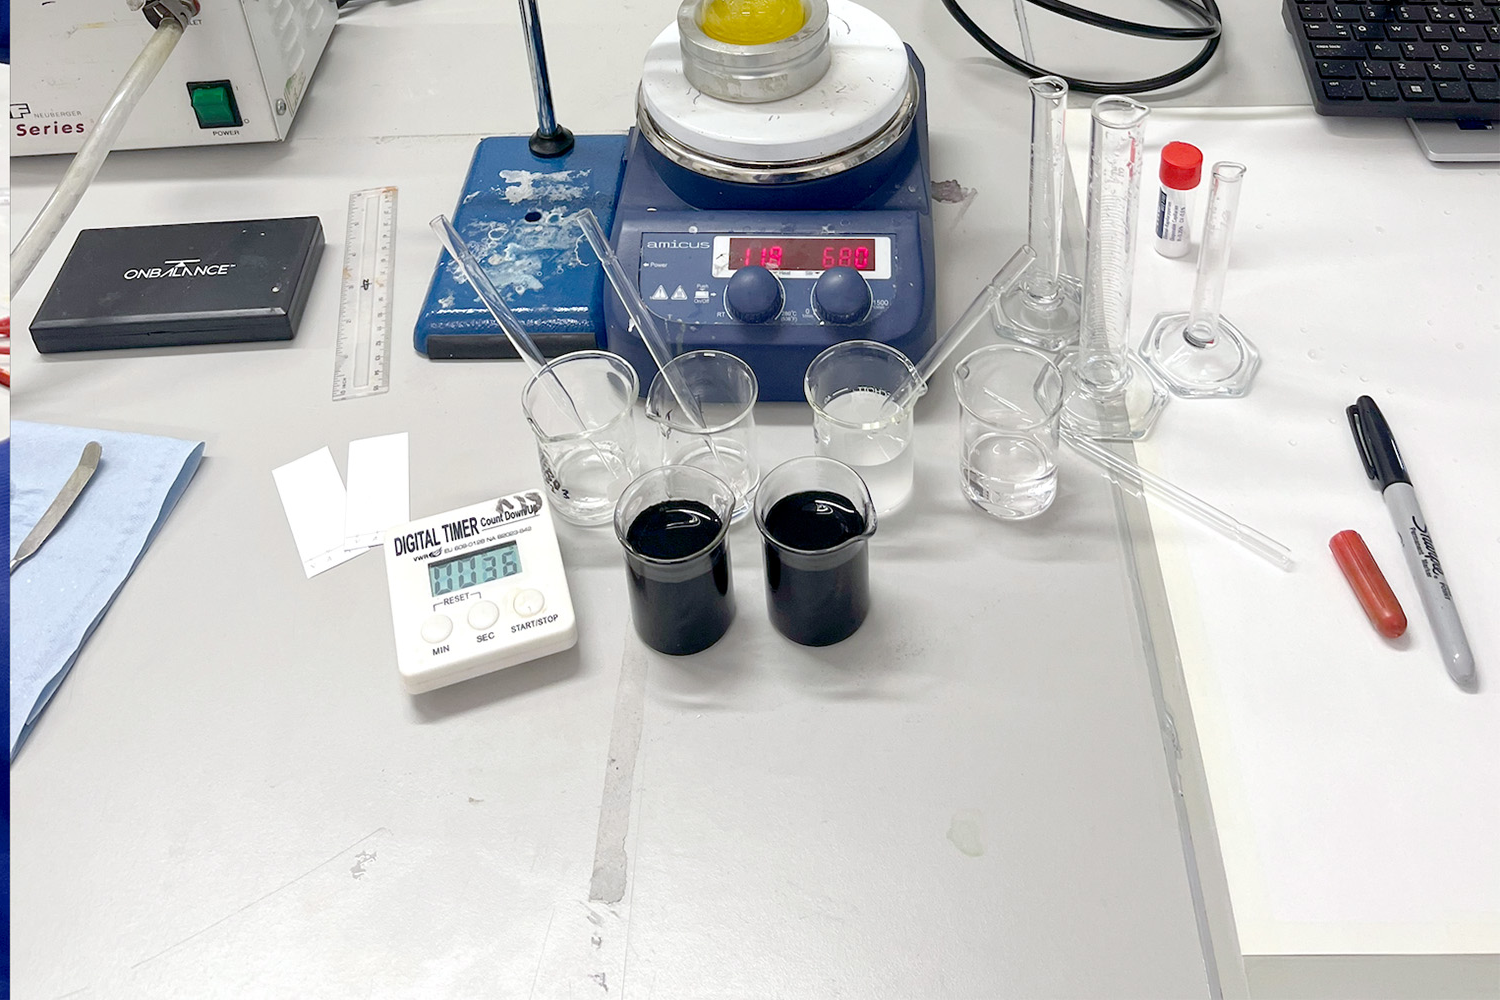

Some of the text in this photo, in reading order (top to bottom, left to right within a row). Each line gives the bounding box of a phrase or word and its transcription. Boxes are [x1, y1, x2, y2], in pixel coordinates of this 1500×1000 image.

[33, 110, 83, 119] NEUBERGER
[16, 120, 85, 137] Series
[647, 240, 710, 249] amicus
[822, 246, 869, 269] 680
[123, 264, 230, 280] ONBALANCE
[394, 528, 441, 556] DIGITAL
[441, 517, 480, 543] TIMER
[480, 512, 504, 527] Count
[413, 554, 429, 562] VWR
[443, 592, 470, 606] RESET
[510, 613, 559, 633] START/STOP
[476, 632, 495, 643] SEC
[432, 644, 451, 656] MIN
